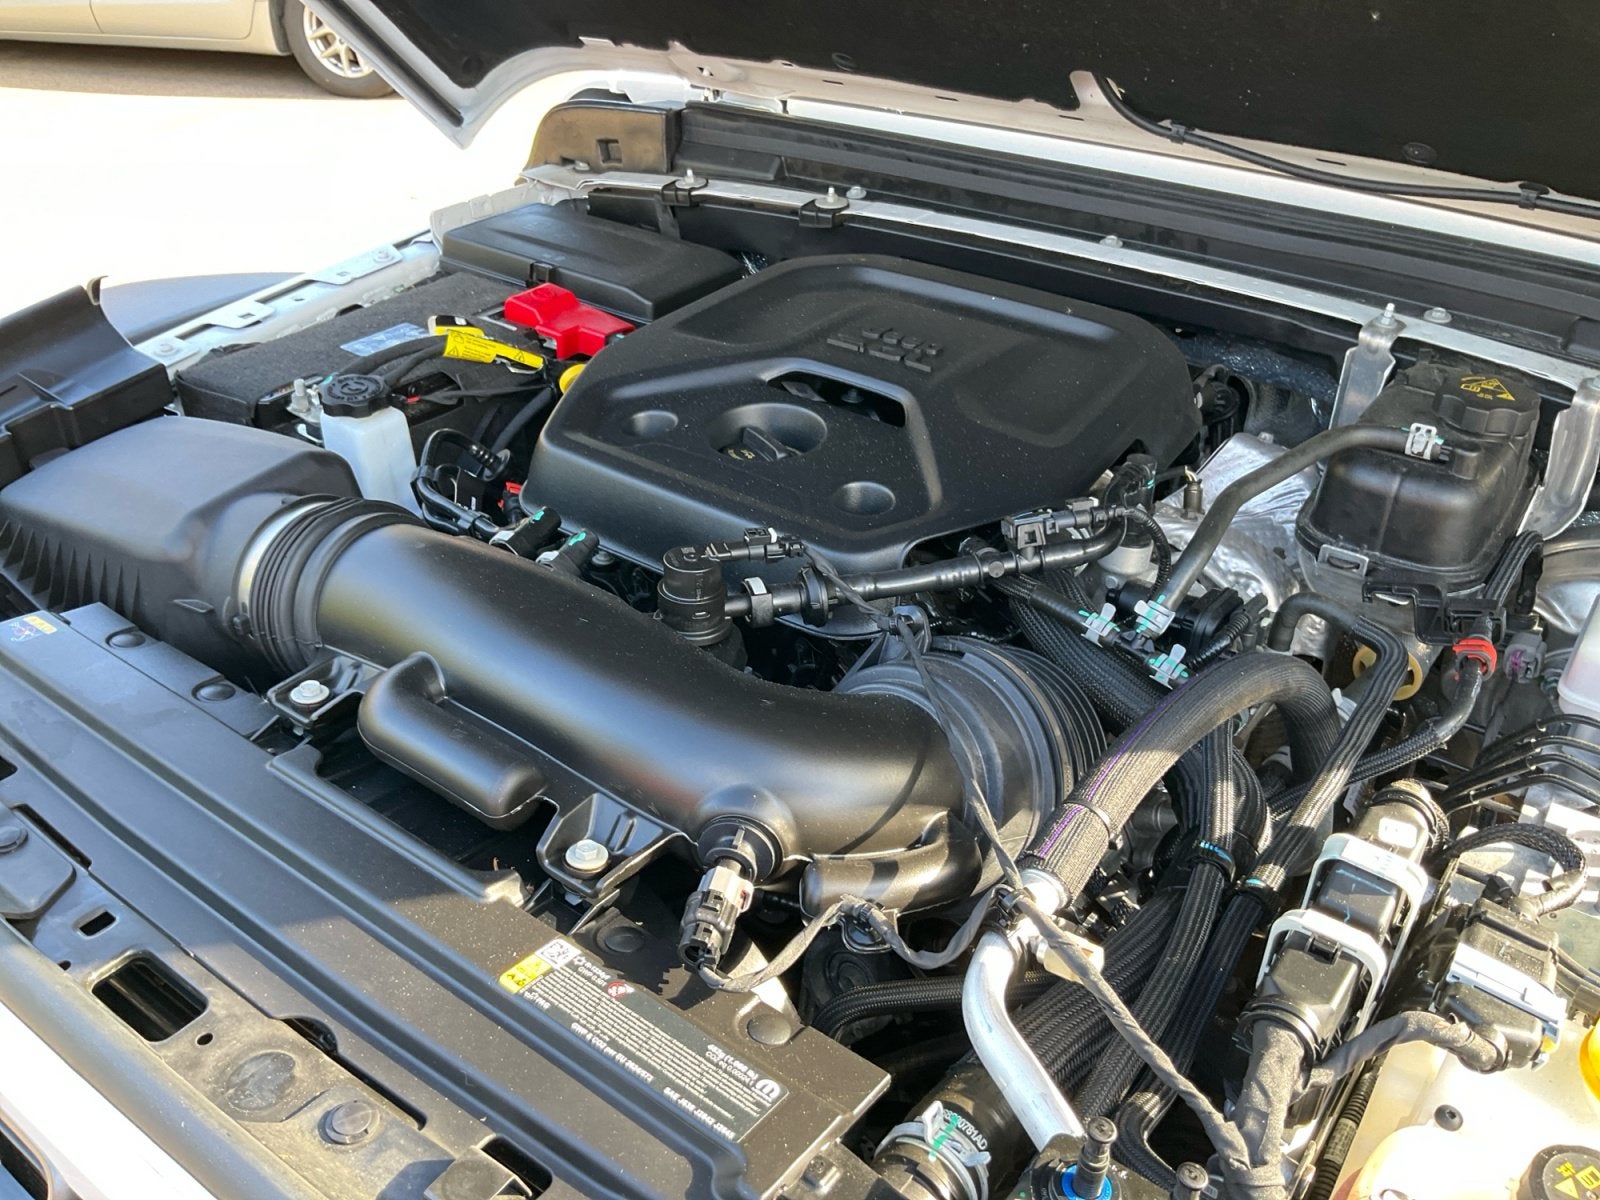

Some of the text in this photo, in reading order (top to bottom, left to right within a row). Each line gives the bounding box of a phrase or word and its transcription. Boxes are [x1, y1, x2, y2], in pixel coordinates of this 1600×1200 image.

[577, 966, 593, 978] GWP
[705, 1051, 720, 1062] CO2
[663, 1086, 681, 1101] SAE
[943, 1109, 988, 1150] 680781AD
